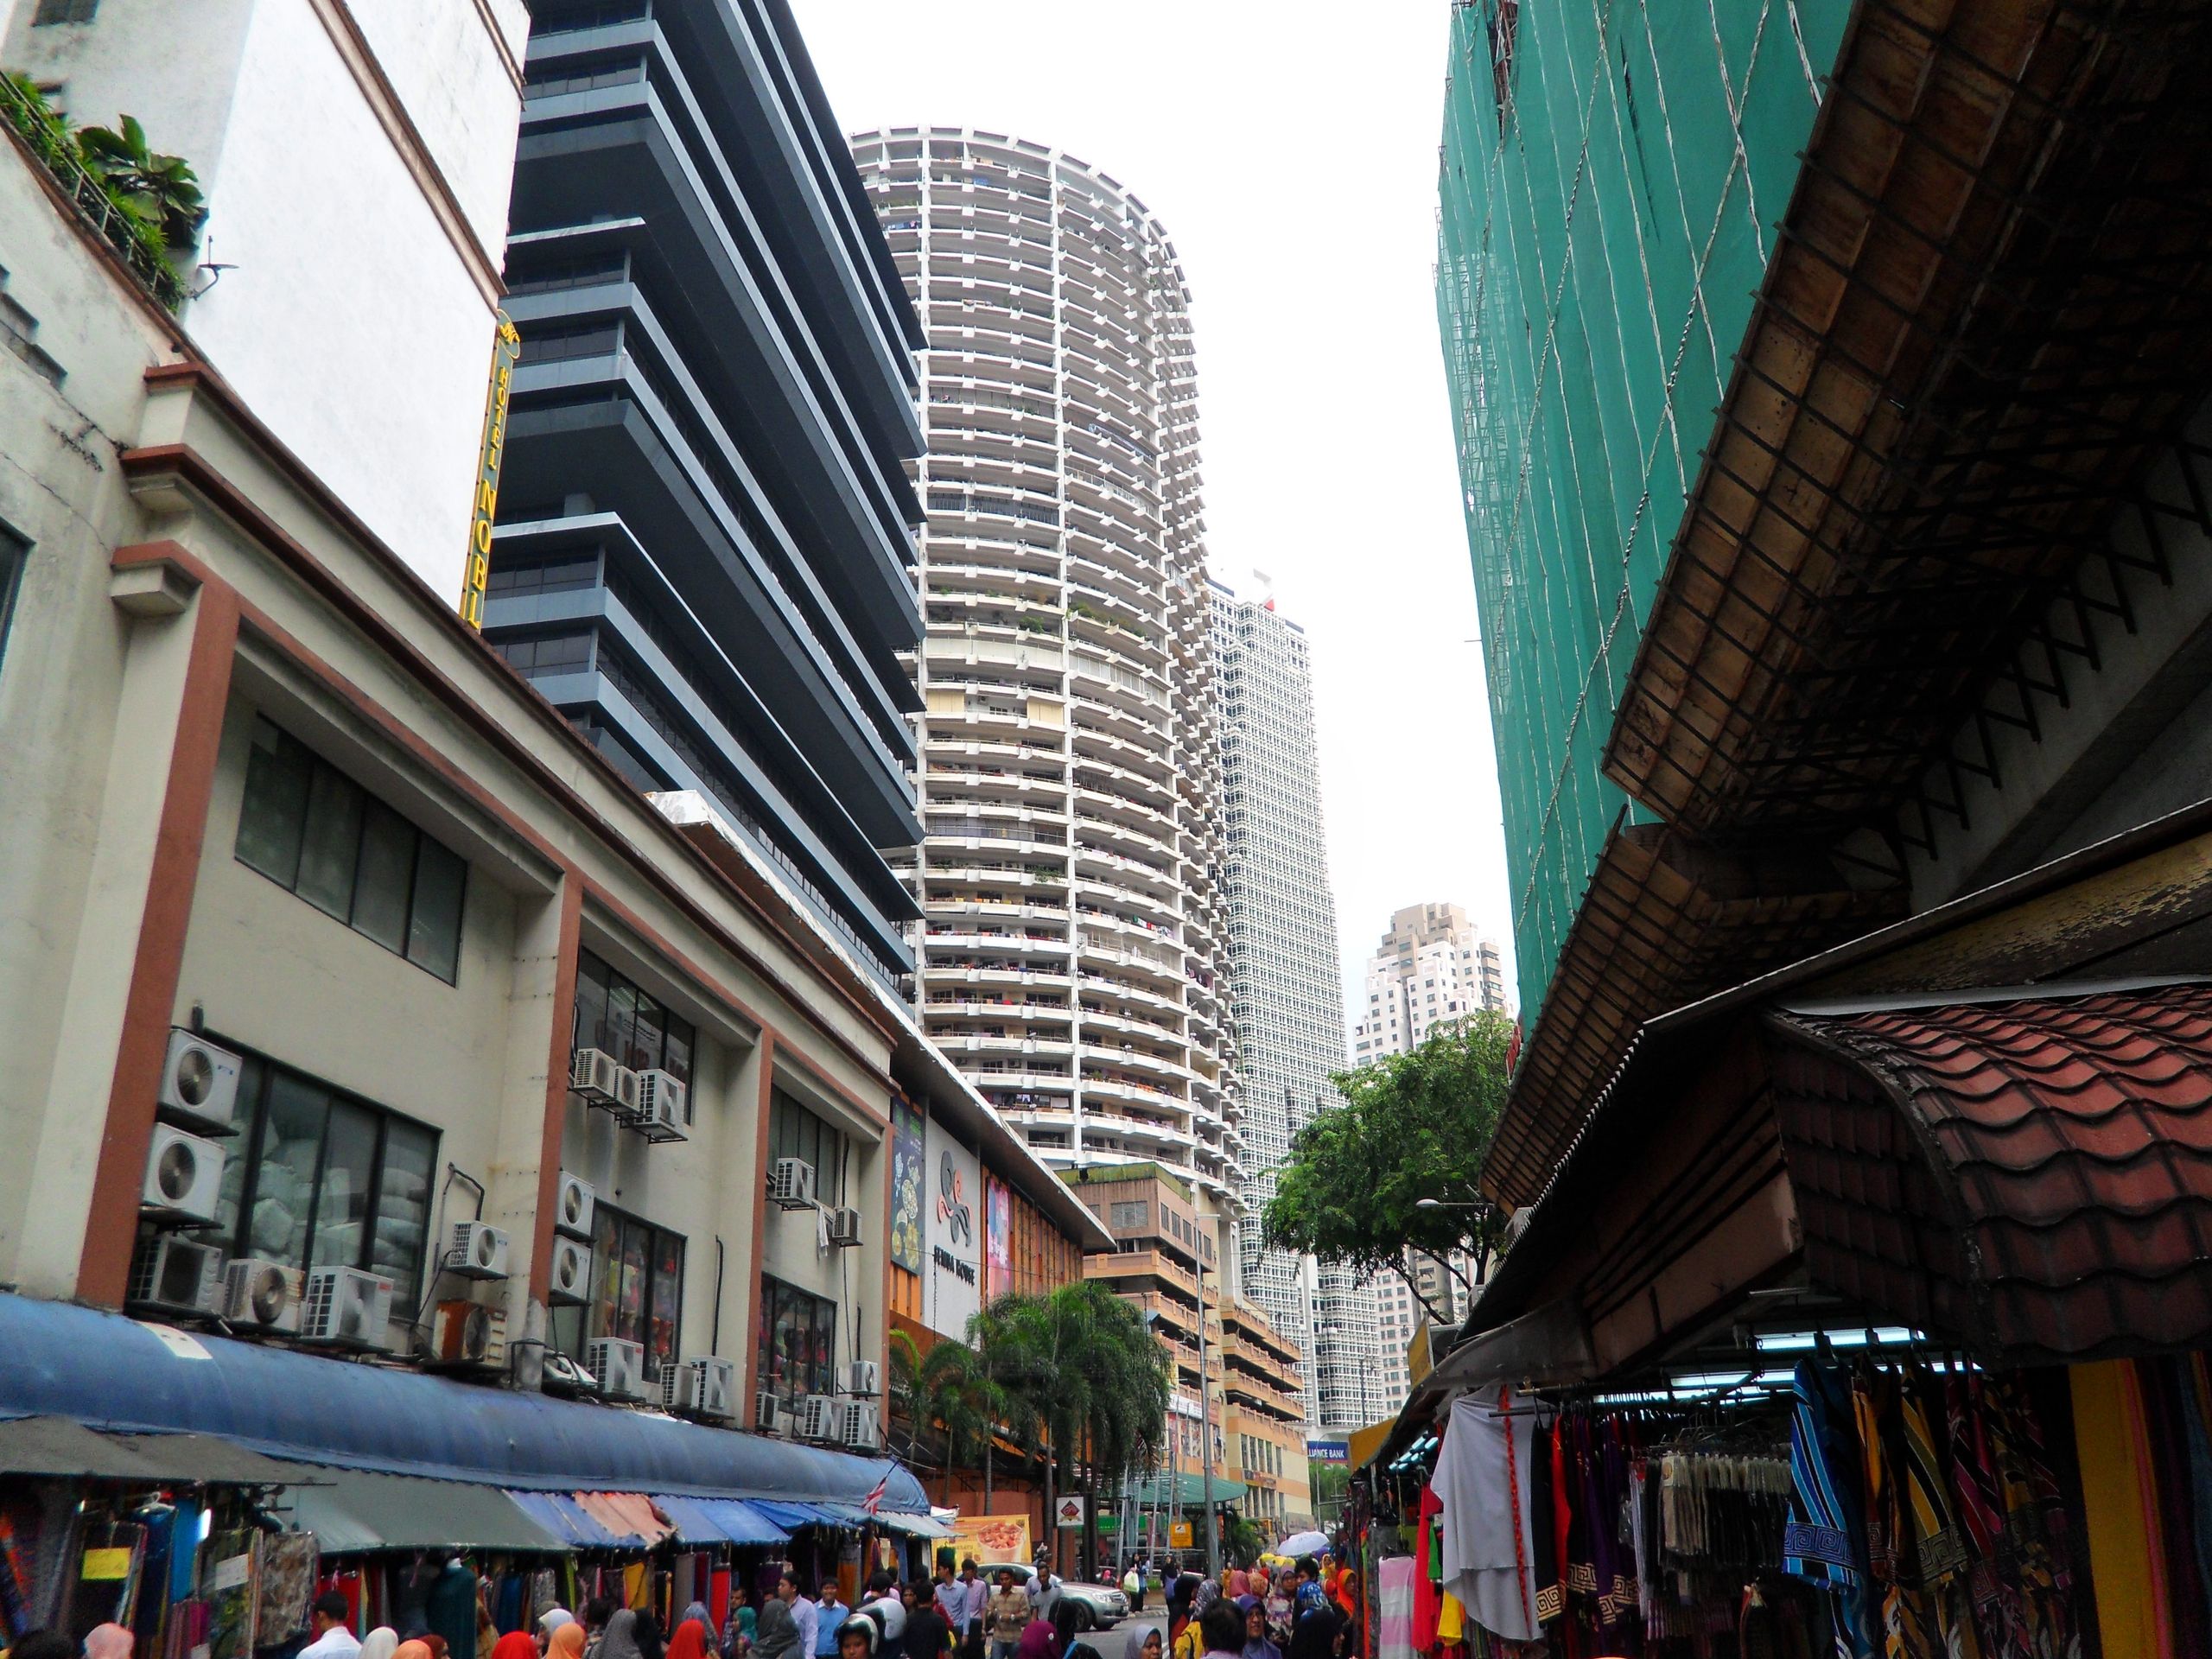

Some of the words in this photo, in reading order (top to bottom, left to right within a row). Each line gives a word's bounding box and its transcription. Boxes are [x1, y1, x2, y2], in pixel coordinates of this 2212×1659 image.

[488, 365, 508, 470] HOTEL
[956, 1259, 975, 1287] HOUSE
[1329, 1449, 1344, 1459] BANK
